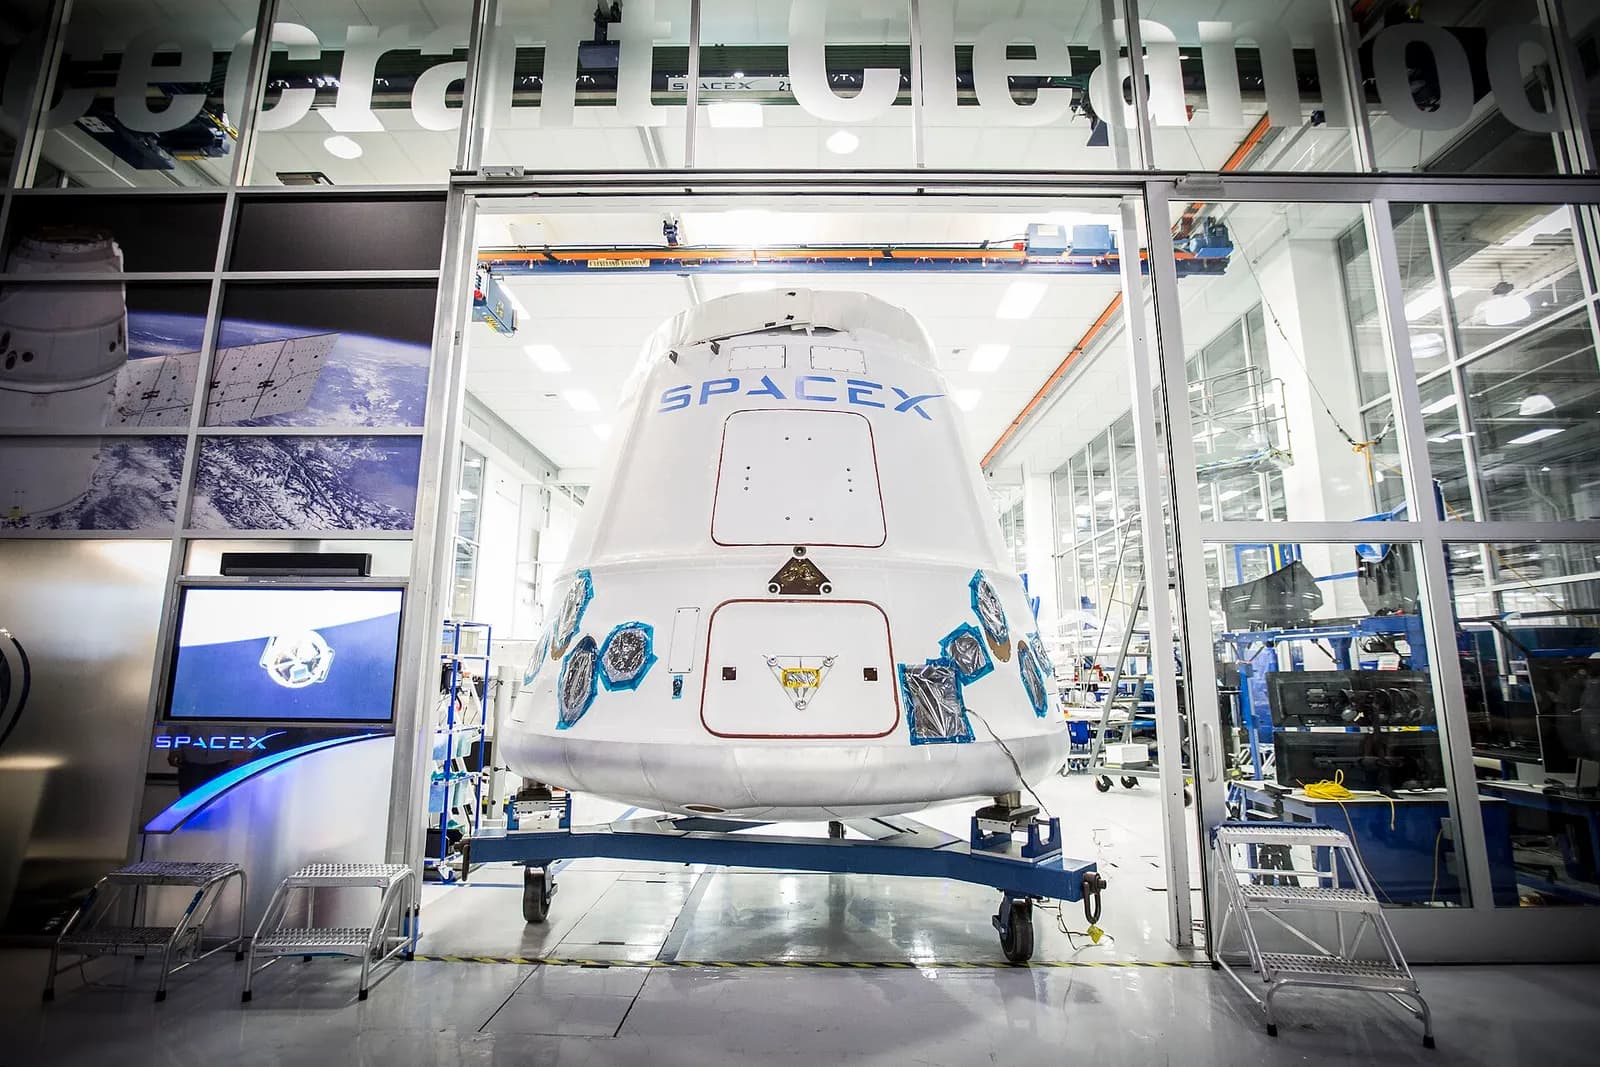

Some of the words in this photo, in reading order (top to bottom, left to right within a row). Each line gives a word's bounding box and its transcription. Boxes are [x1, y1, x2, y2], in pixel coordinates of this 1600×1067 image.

[672, 79, 759, 90] SACEX
[658, 375, 945, 420] SPACEX
[155, 731, 287, 749] SPACEX
